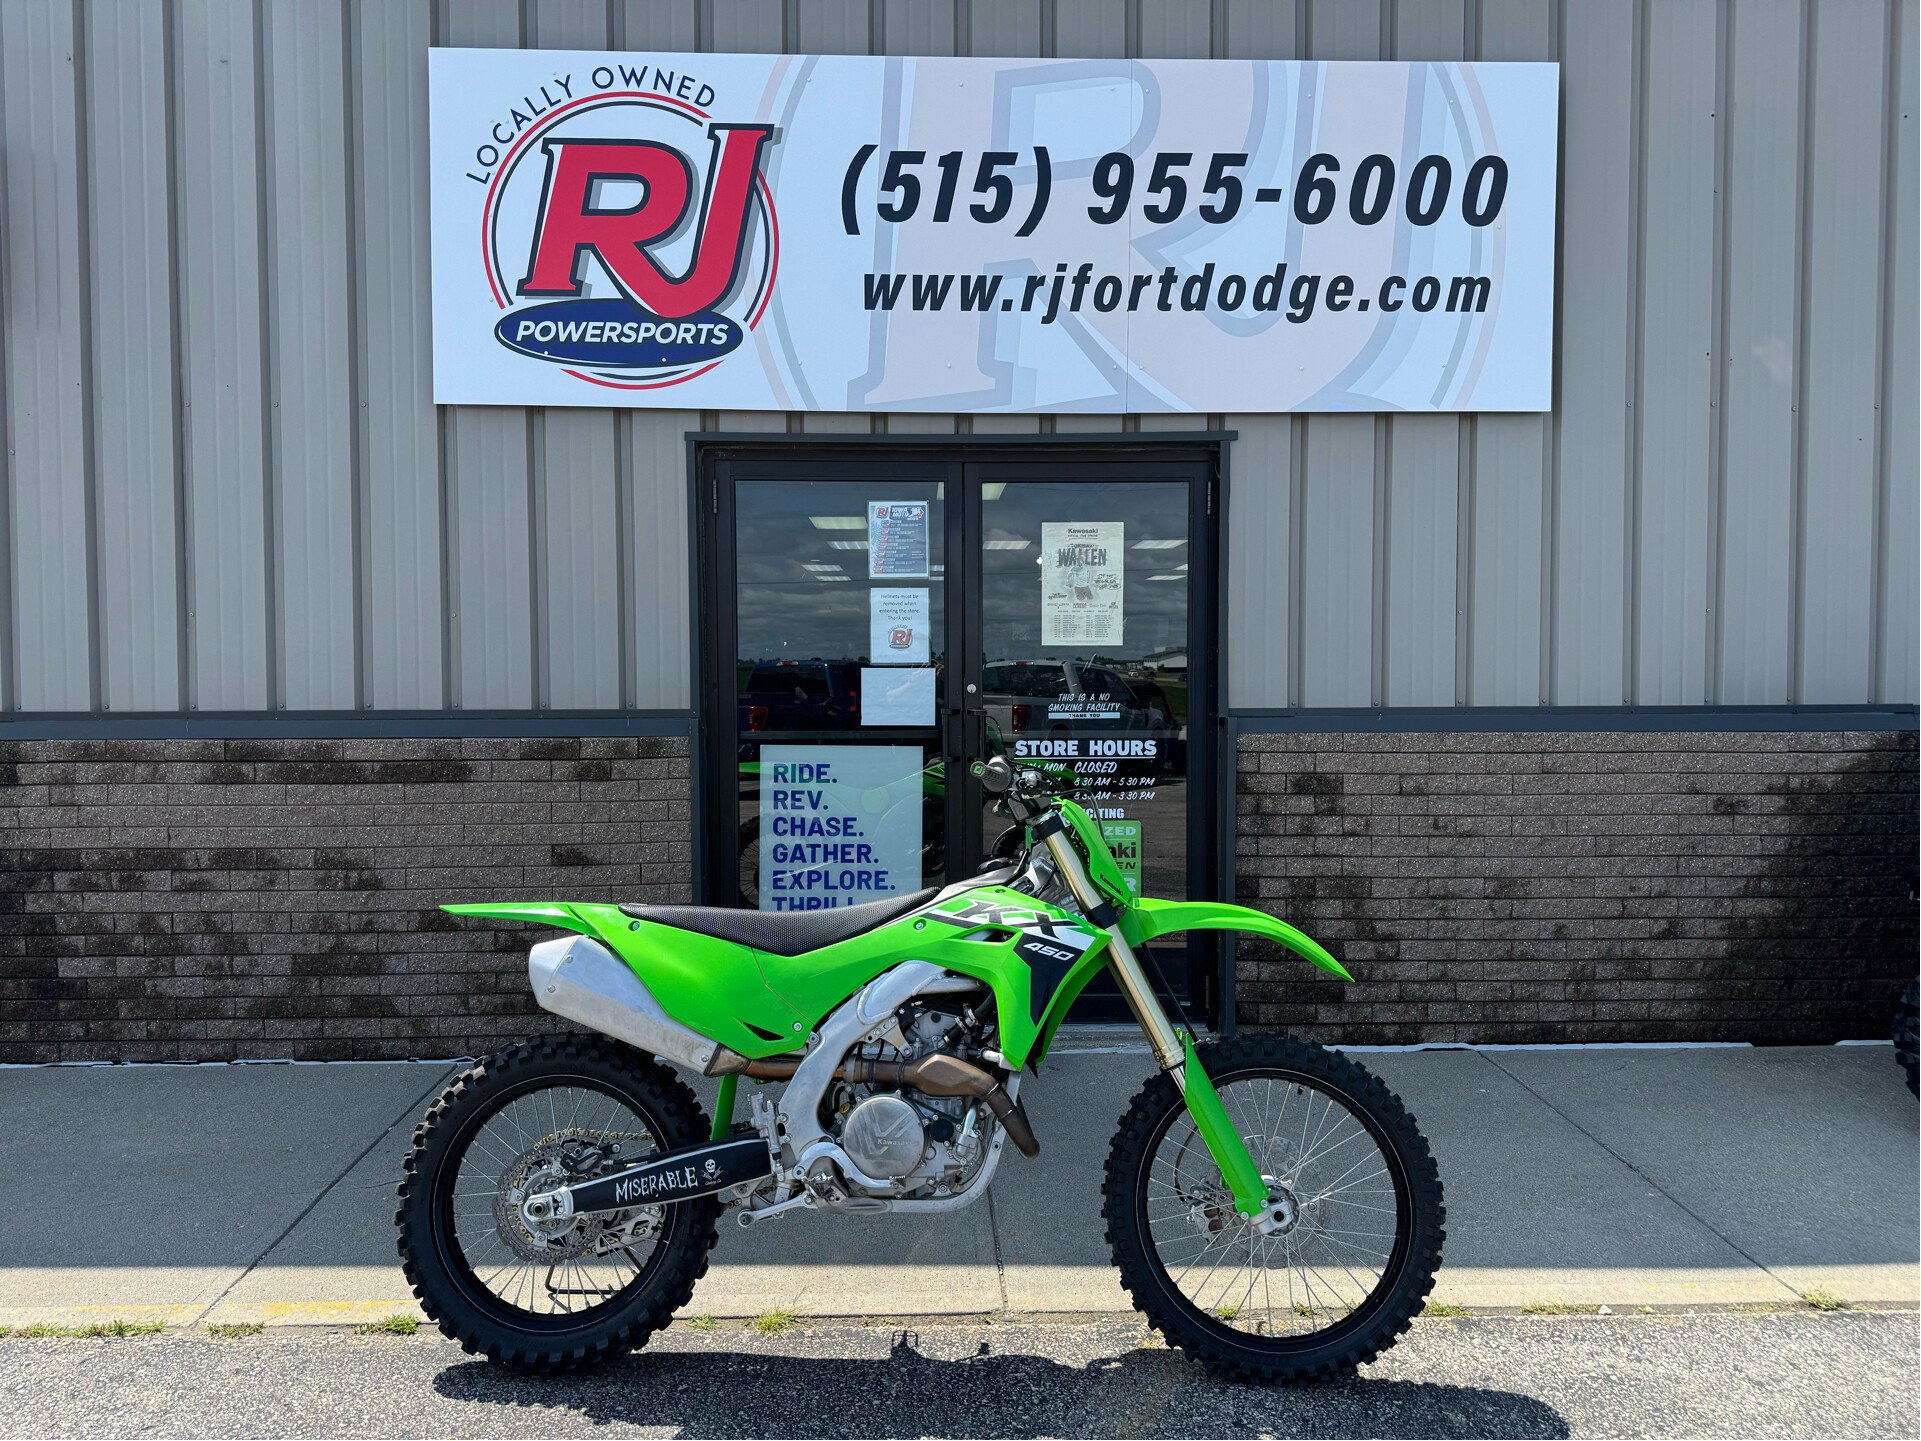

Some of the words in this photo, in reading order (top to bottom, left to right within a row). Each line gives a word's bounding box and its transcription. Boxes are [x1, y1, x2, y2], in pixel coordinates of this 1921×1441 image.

[466, 73, 572, 184] LOCALLY
[591, 64, 716, 107] OWNED
[841, 144, 1053, 237] (515)
[1087, 151, 1509, 228] 955-6000
[516, 123, 779, 319] RJ
[862, 262, 1491, 325] www.rjfortdodge.com
[516, 319, 732, 346] POWERSPORTS
[1048, 703, 1083, 711] SMOKING
[1086, 702, 1121, 711] FACILITY
[1058, 693, 1075, 701] THIS
[1078, 693, 1086, 701] IS
[1089, 693, 1095, 701] A
[1098, 693, 1110, 701] NO
[1015, 740, 1079, 756] STORE
[1089, 739, 1157, 756] HOURS
[773, 763, 838, 784] RIDE.
[1043, 762, 1067, 771] MON
[1074, 761, 1118, 773] CLOSED
[1094, 777, 1111, 786] AM
[1139, 776, 1156, 786] PM
[773, 790, 829, 810] REV.
[1094, 791, 1111, 800] AM
[1139, 791, 1156, 800] PM
[772, 816, 864, 837] CHASE.
[772, 843, 879, 864] GATHER.
[772, 870, 896, 890] EXPLORE.
[950, 898, 1083, 941] KX
[1023, 942, 1075, 961] 450
[615, 1166, 699, 1203] MISERABLE
